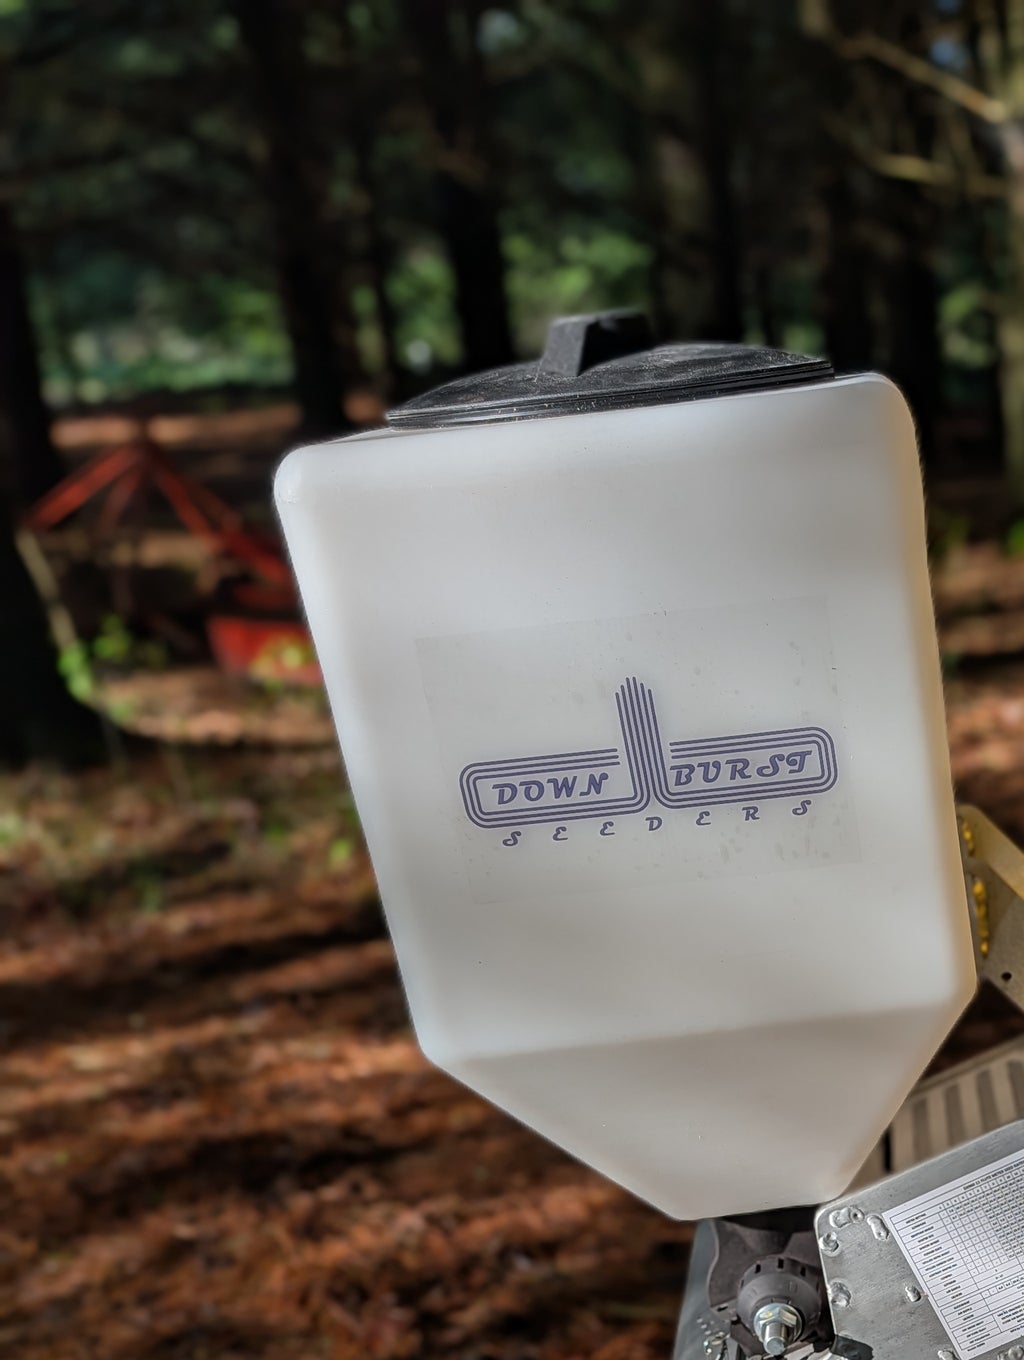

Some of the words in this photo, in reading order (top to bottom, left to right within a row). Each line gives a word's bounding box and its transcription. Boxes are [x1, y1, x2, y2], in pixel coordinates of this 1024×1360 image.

[491, 772, 609, 805] DOWN
[669, 750, 812, 787] BURST
[502, 799, 812, 847] SEEDERS
